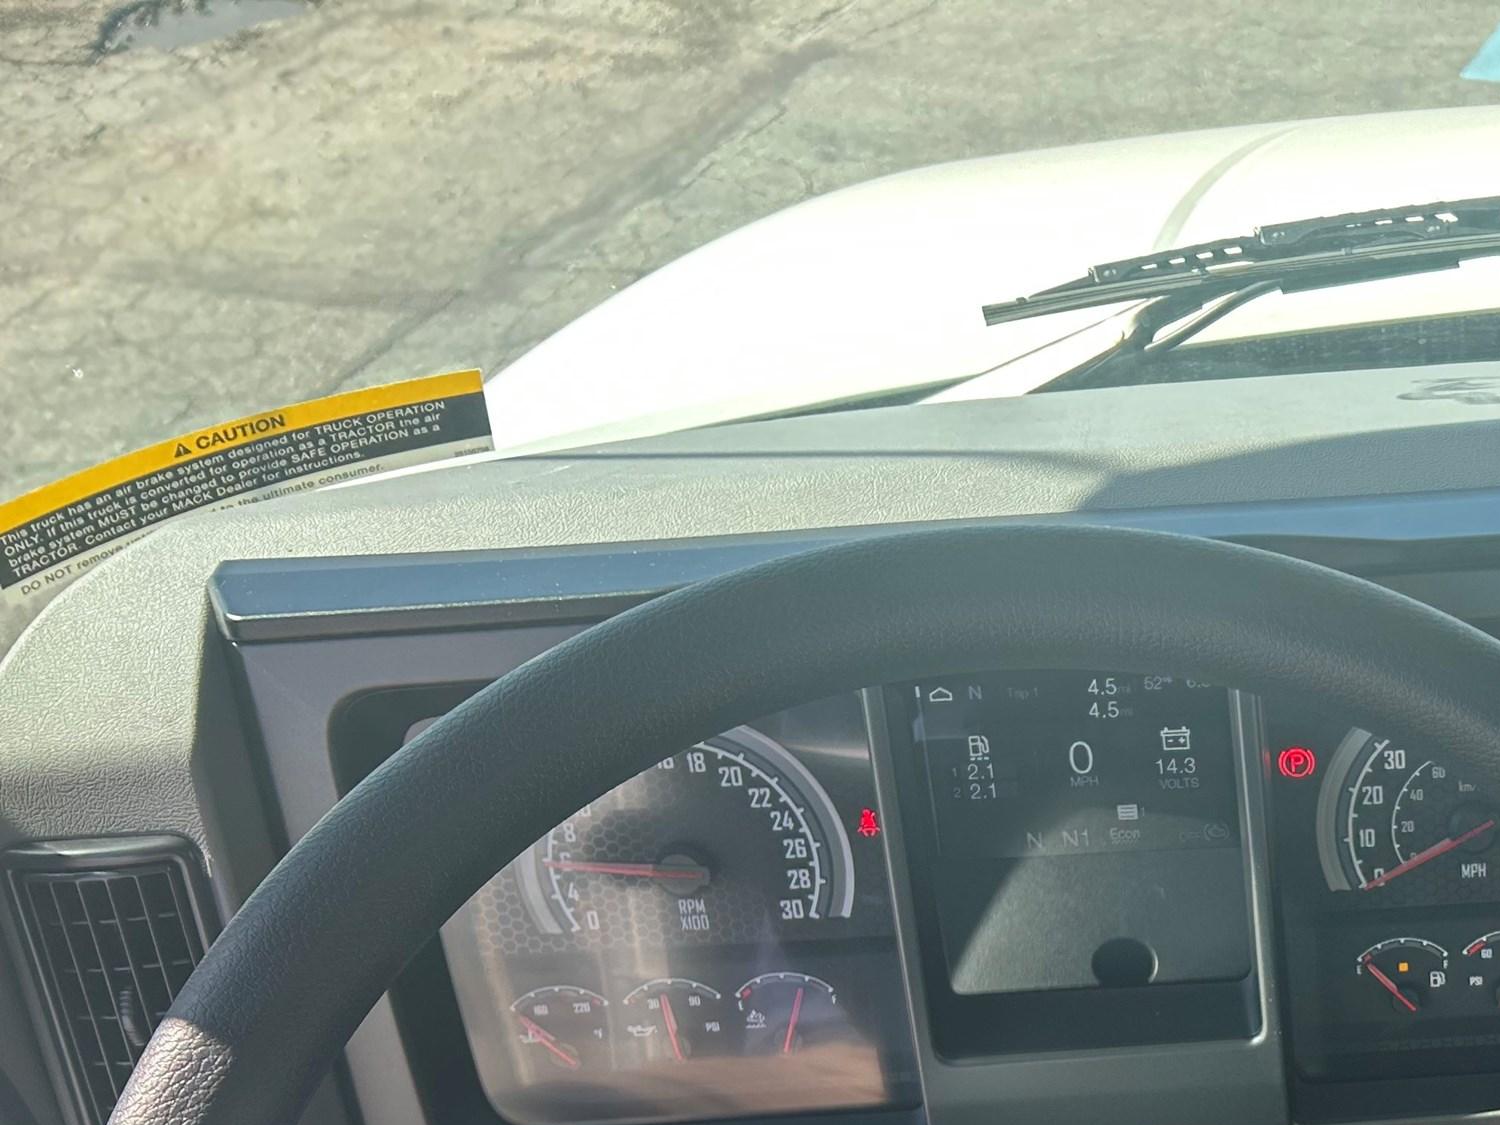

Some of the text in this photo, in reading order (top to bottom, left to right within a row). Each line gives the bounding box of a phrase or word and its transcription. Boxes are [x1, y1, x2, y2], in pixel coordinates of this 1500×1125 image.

[196, 414, 286, 449] CAUTION
[0, 400, 446, 546] This truck has an air brake system designed for TRUCK OPERATION
[262, 462, 384, 502] ultimate consumer.
[4, 534, 44, 557] ONLY.
[47, 525, 58, 538] If
[59, 515, 85, 533] this
[87, 501, 122, 520] truck
[125, 494, 138, 506] is
[140, 471, 206, 500] converted
[209, 463, 229, 476] for
[232, 445, 295, 470] operation
[299, 441, 314, 451] as
[330, 421, 395, 443] TRACTOR
[400, 414, 420, 428] the
[424, 411, 441, 424] air
[8, 546, 46, 569] brake
[49, 524, 95, 550] system
[98, 506, 137, 529] MUST
[141, 498, 158, 512] be
[161, 475, 218, 505] changed
[221, 472, 235, 485] to
[238, 458, 288, 482] provide
[291, 446, 326, 464] SAFE
[330, 428, 409, 455] OPERATION
[413, 425, 429, 436] as
[12, 543, 83, 578] TRACTOR.
[84, 519, 139, 546] Contact
[139, 506, 169, 526] your
[172, 492, 214, 513] MACK
[216, 476, 259, 497] Dealer
[262, 471, 281, 484] for
[284, 451, 365, 477] instructions.
[20, 564, 73, 596] DO NOT
[968, 685, 983, 700] N
[1088, 678, 1117, 695] 4.5
[1089, 701, 1120, 719] 4.5
[686, 752, 707, 774] 18
[1069, 740, 1093, 774] 0
[1155, 757, 1197, 775] 14.3
[1384, 749, 1406, 770] 30
[719, 767, 743, 787] 20
[966, 763, 995, 781] 2.1
[1070, 776, 1099, 788] MPH
[1431, 766, 1446, 779] 60
[969, 782, 997, 801] 2.1
[1159, 777, 1200, 791] VOLTS
[748, 788, 773, 809] 22
[1362, 785, 1384, 805] 20
[1410, 789, 1424, 801] 40
[770, 811, 795, 832] 24
[1401, 821, 1415, 833] 20
[563, 822, 577, 843] 8
[1026, 829, 1090, 850] N N1
[1359, 828, 1376, 848] 10
[783, 838, 808, 859] 26
[787, 868, 811, 890] 28
[1461, 863, 1487, 879] MPH
[568, 882, 580, 901] 4
[678, 898, 706, 915] RPM
[780, 899, 805, 920] 30
[587, 911, 600, 931] 0
[680, 914, 710, 931] X100
[1469, 975, 1484, 987] PSI
